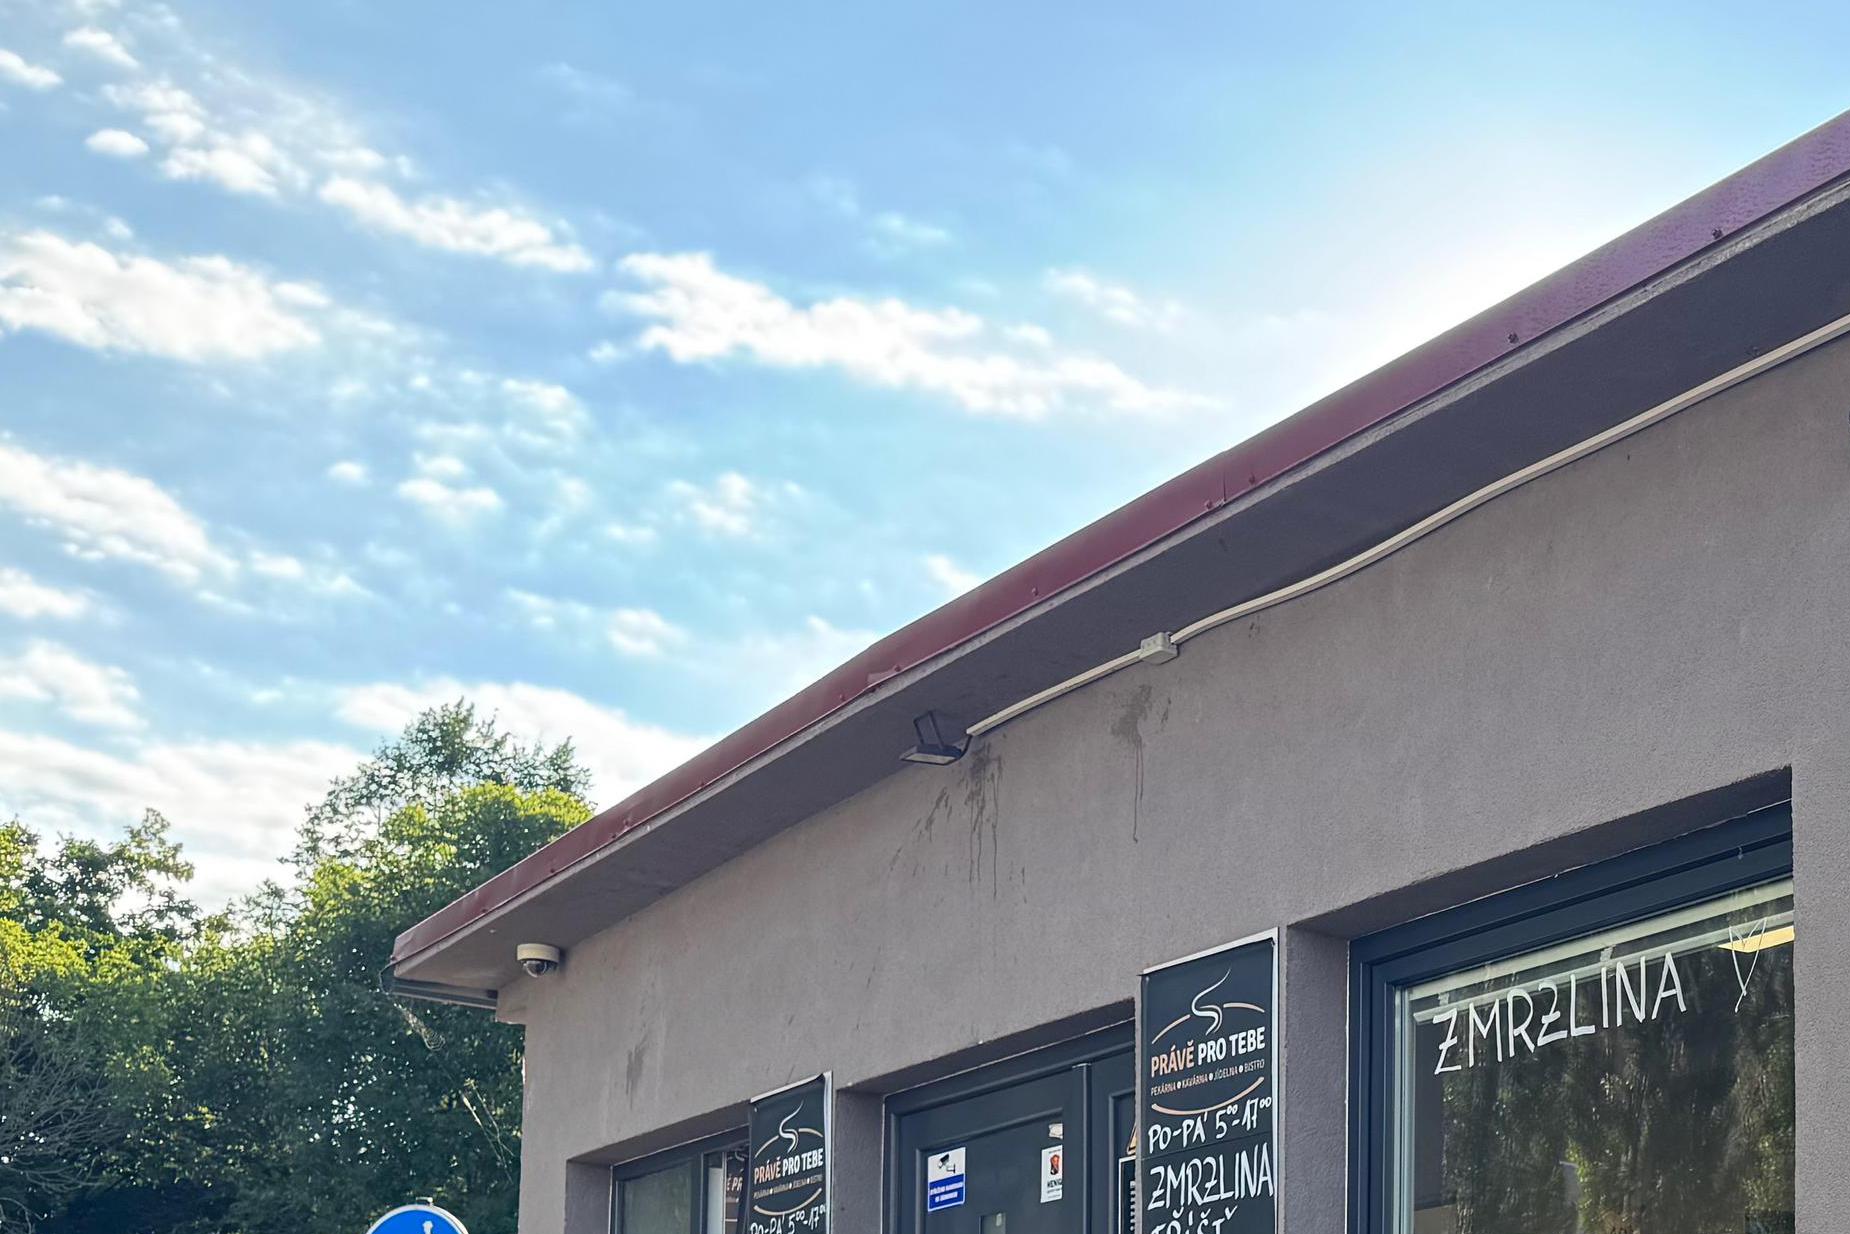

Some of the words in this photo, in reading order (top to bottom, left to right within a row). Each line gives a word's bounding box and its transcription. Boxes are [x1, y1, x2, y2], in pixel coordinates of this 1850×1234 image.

[1151, 1040, 1194, 1077] PRÁVĚ
[1198, 1038, 1226, 1065] PRO
[1229, 1027, 1265, 1056] TEBE
[754, 1156, 781, 1184] PRÁVĚ
[783, 1155, 800, 1176] PRO
[802, 1148, 823, 1171] TEBE
